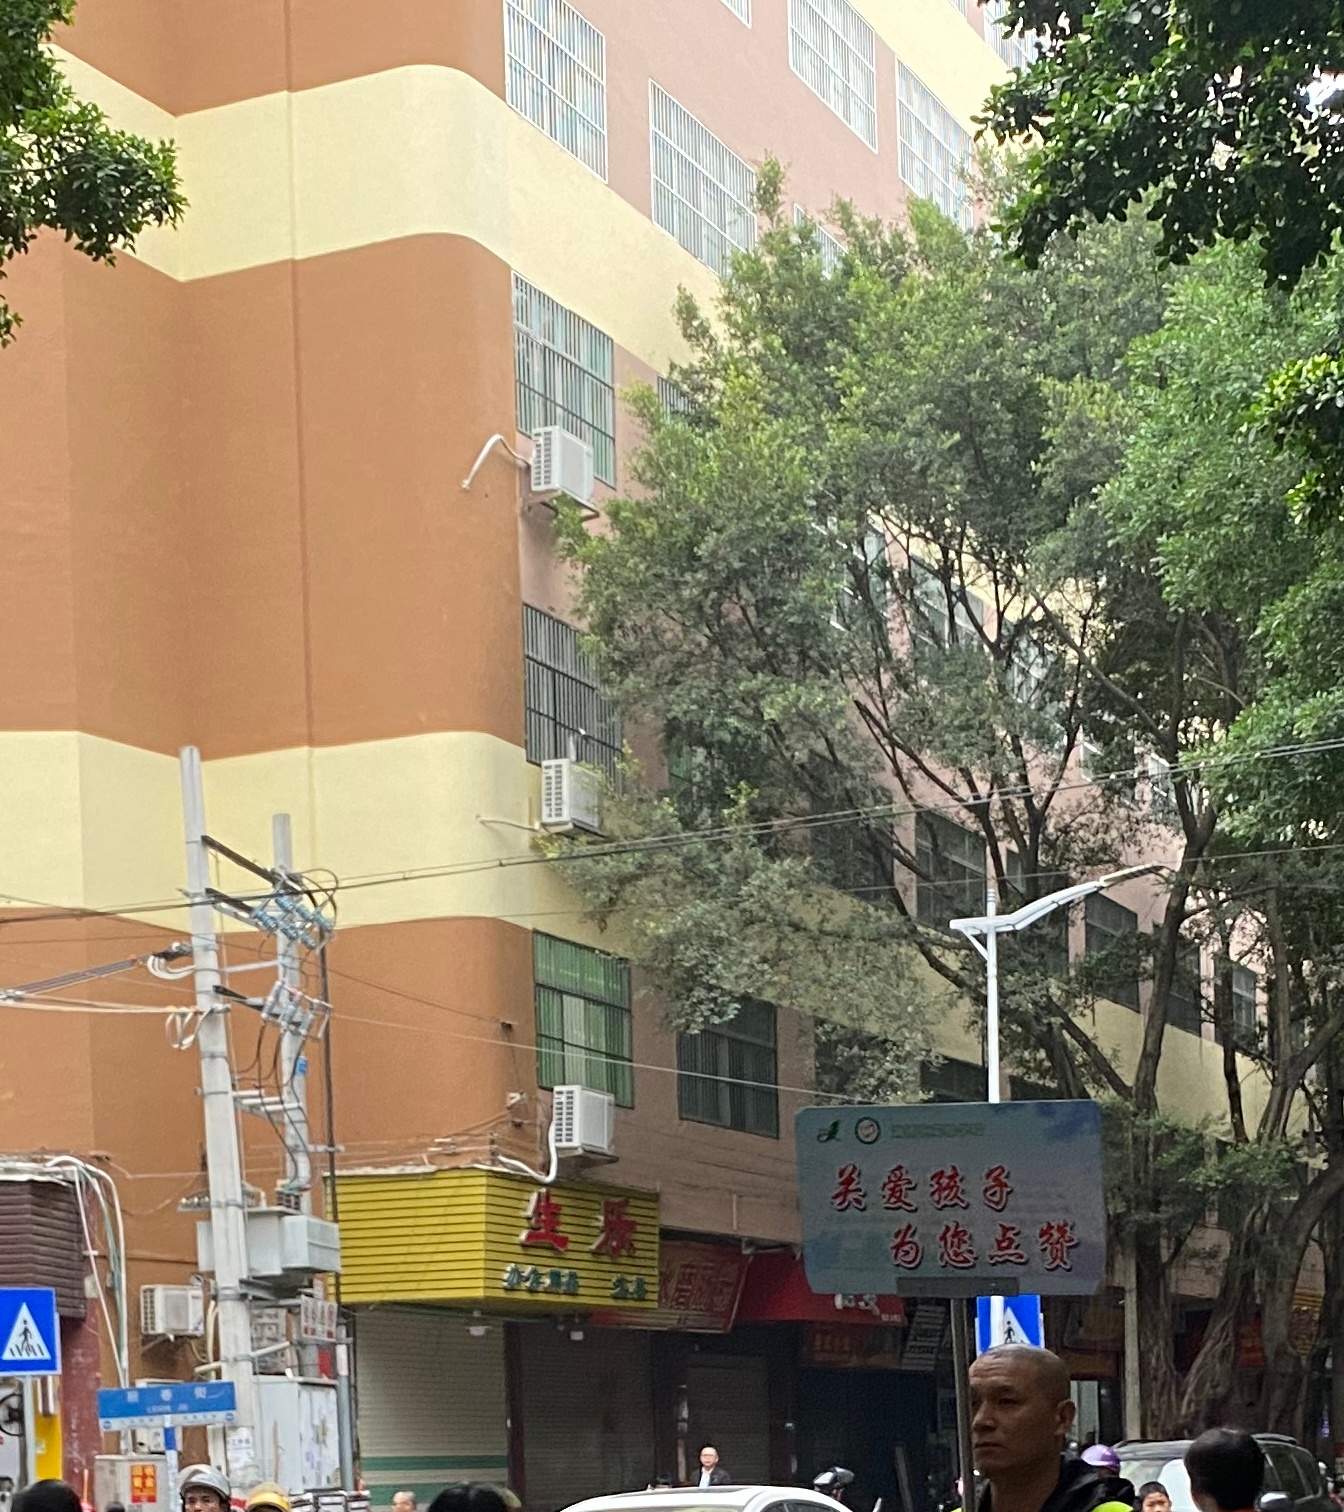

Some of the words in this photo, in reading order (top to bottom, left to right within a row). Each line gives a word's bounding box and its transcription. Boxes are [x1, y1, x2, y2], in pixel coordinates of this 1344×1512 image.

[831, 1163, 1013, 1211] 关爱孩子
[890, 1220, 1081, 1271] 为您点赞
